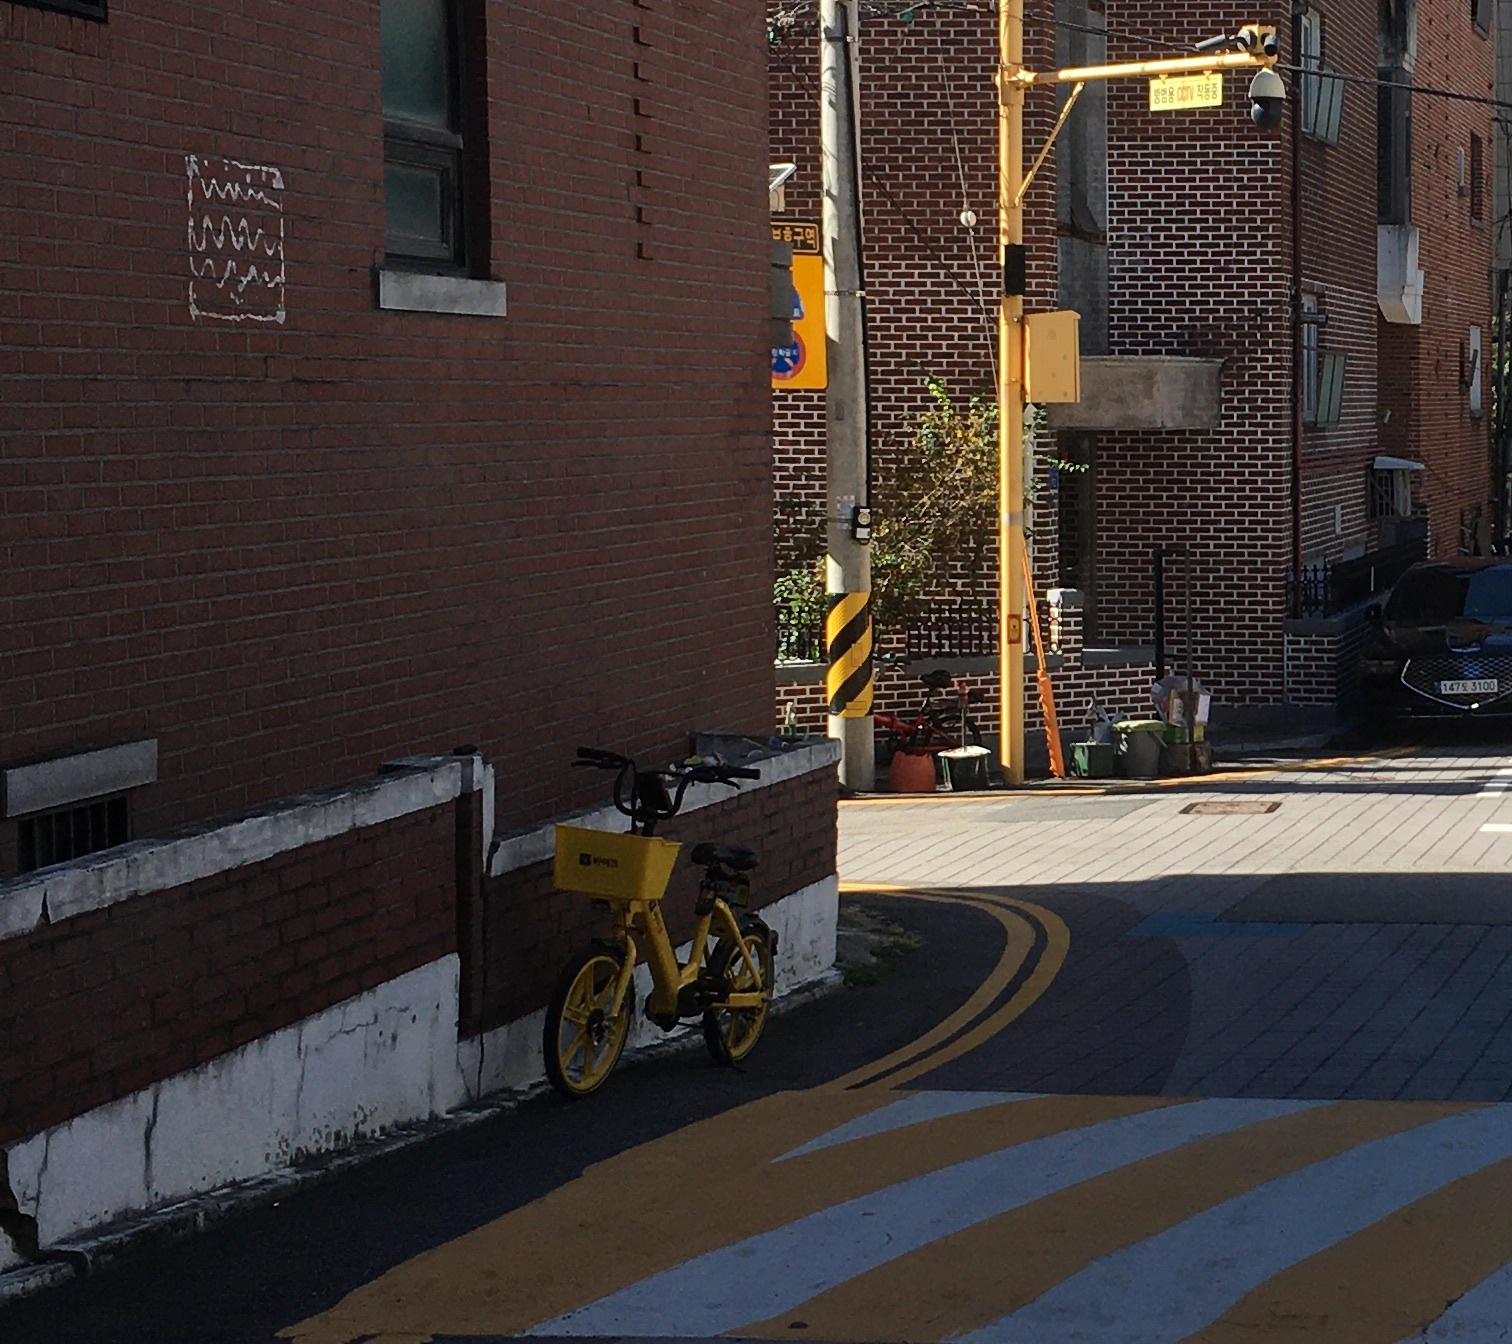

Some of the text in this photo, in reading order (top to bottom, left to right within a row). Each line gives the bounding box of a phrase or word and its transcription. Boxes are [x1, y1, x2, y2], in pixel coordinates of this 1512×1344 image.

[1177, 85, 1195, 102] CCTV
[1197, 82, 1217, 100] 작동중
[1471, 680, 1496, 692] 3100
